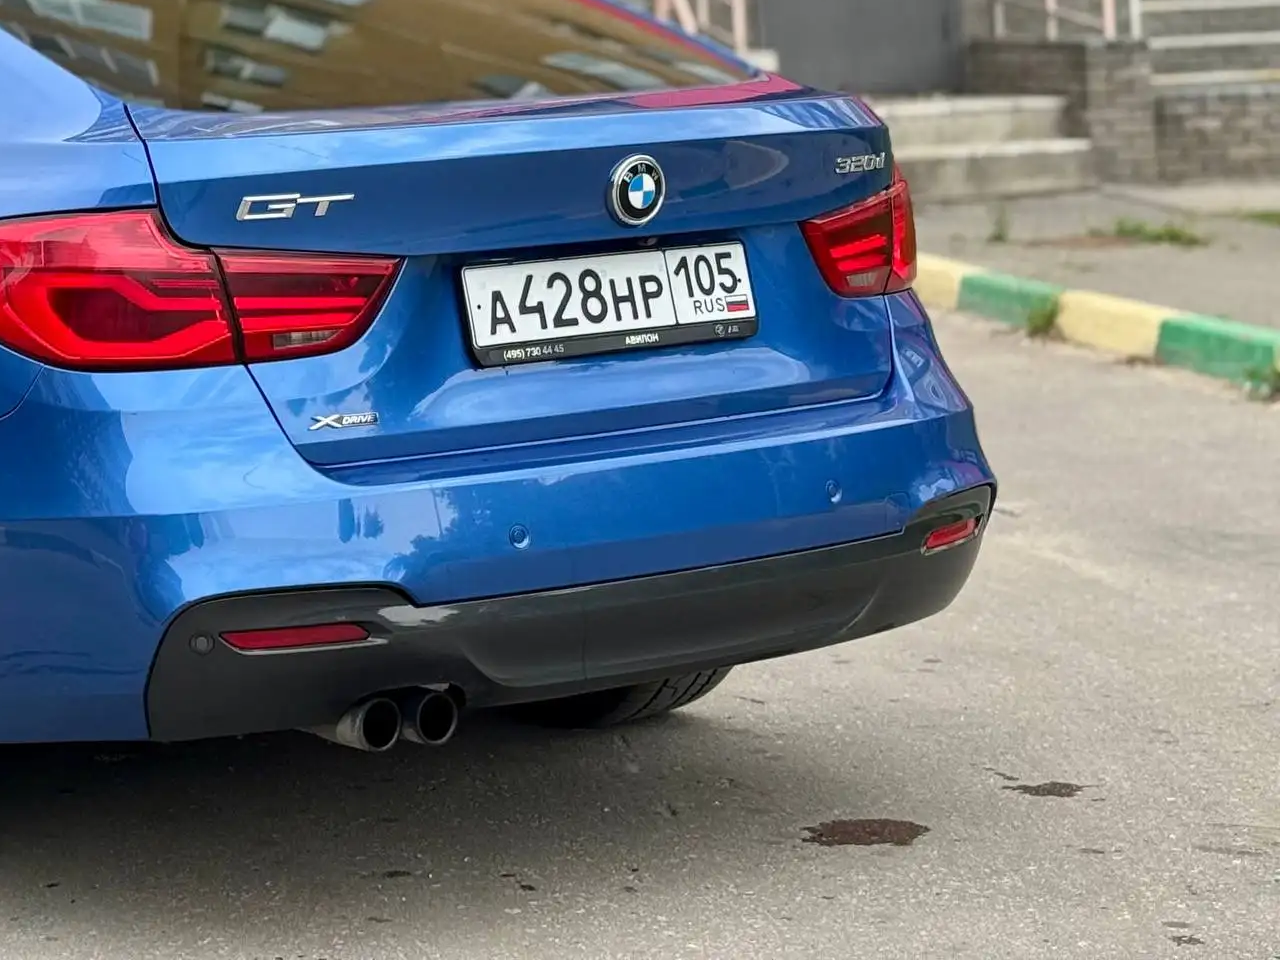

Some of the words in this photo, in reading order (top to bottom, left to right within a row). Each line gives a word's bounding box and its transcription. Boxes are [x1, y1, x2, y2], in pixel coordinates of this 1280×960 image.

[835, 151, 886, 174] 320d
[623, 163, 660, 183] BMW
[235, 193, 355, 221] GT
[673, 251, 739, 298] 105
[693, 299, 725, 316] RUS
[625, 333, 660, 346] АВИЛОН
[503, 348, 526, 361] (495)
[526, 345, 542, 357] 730
